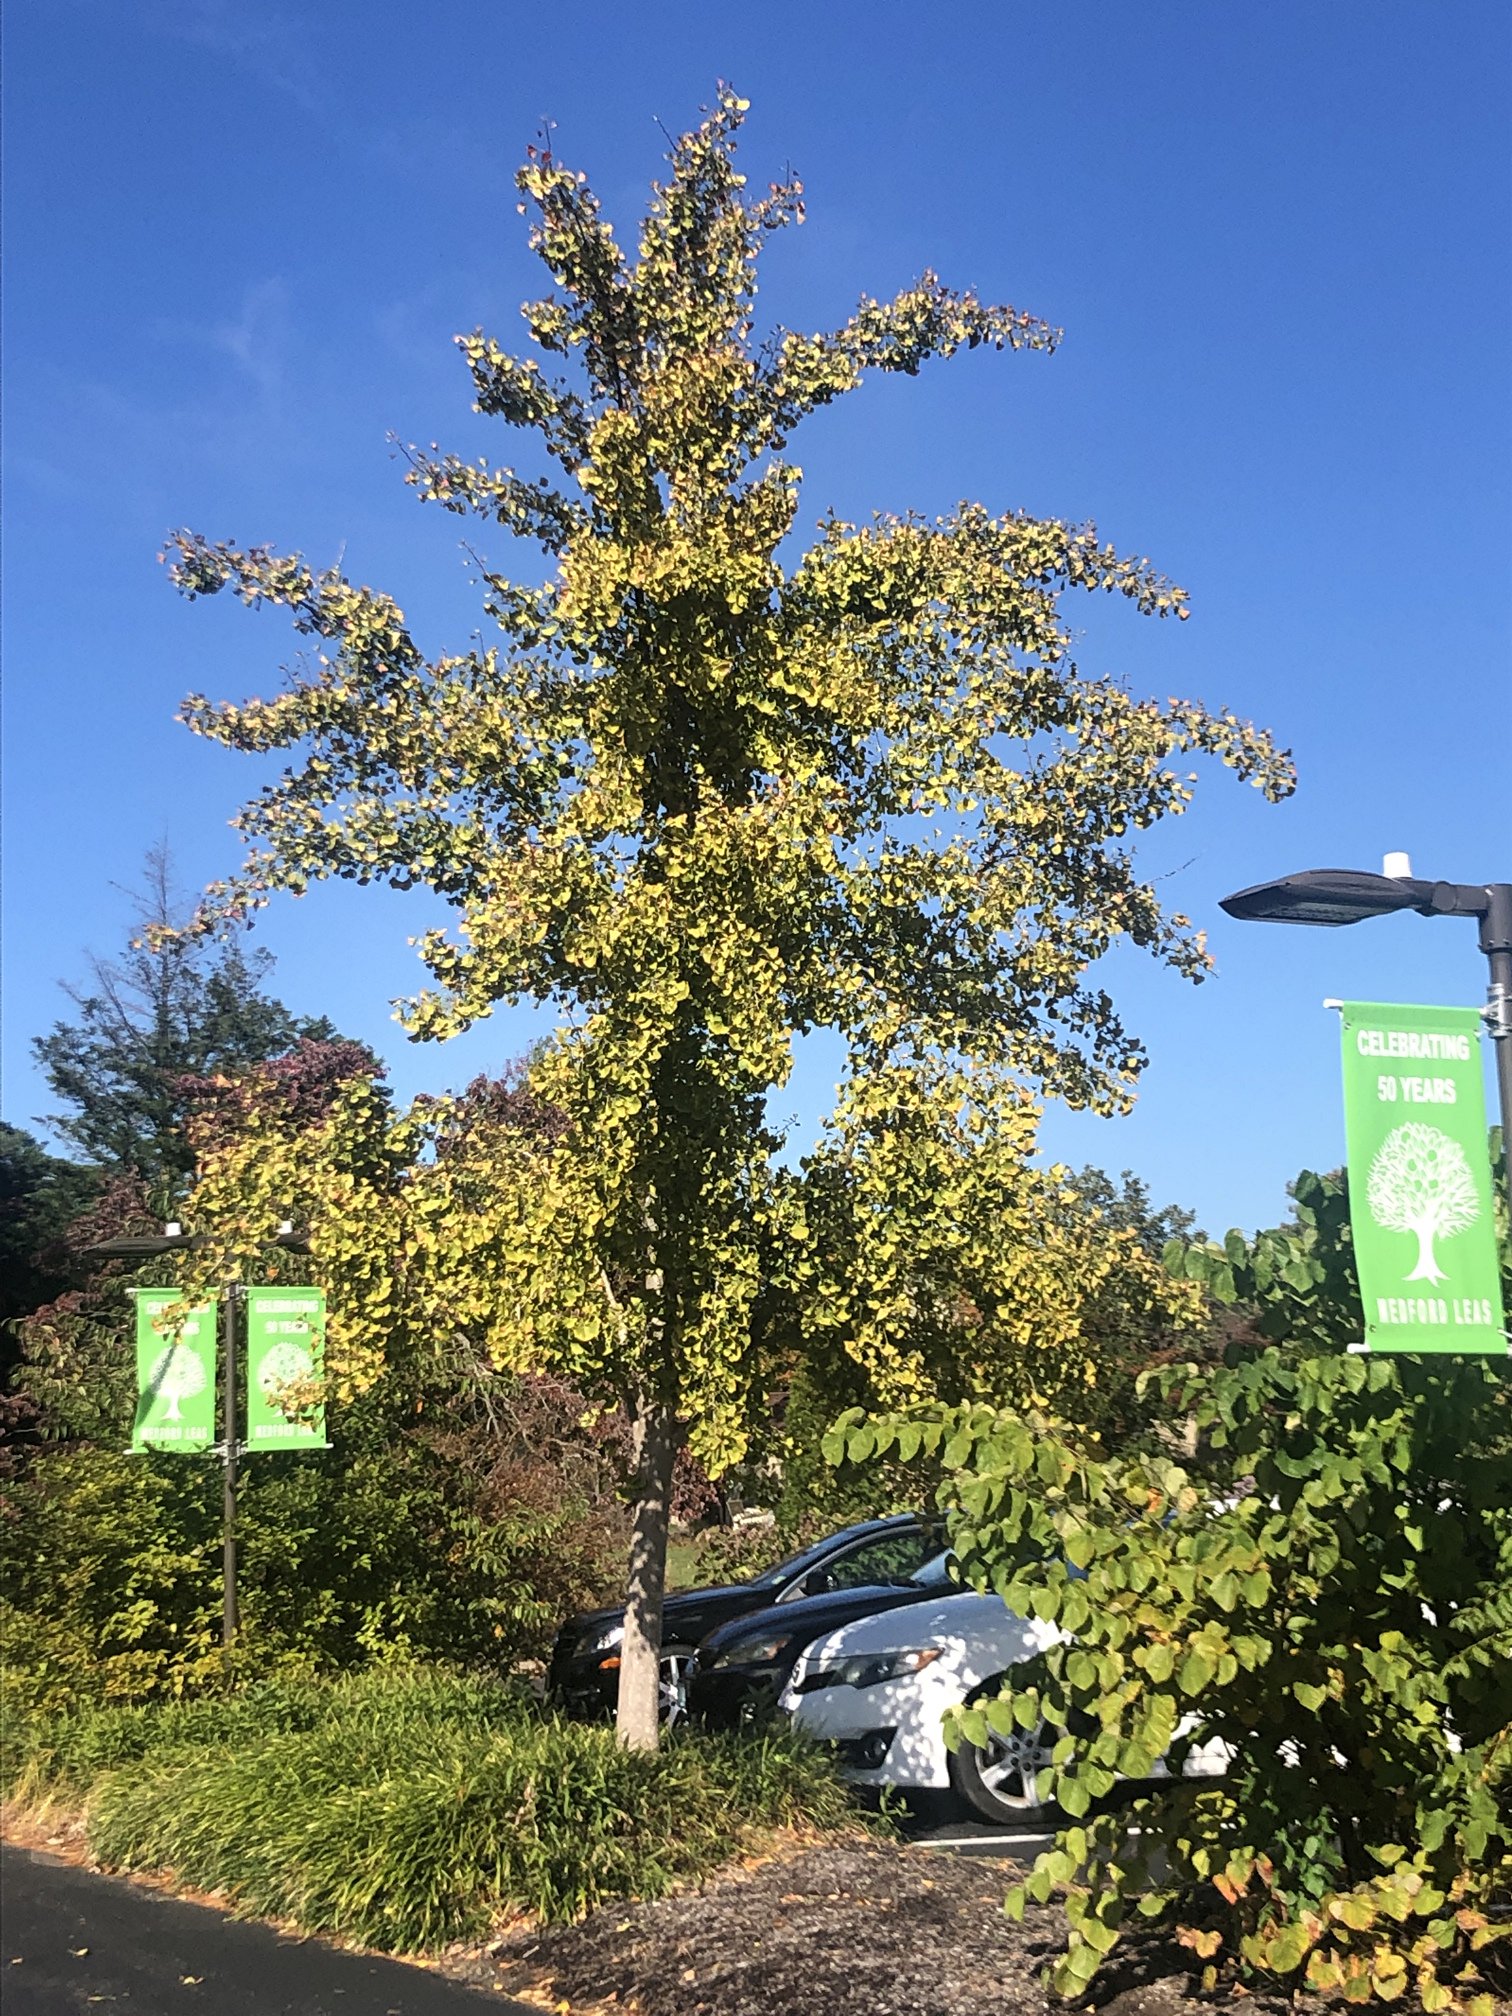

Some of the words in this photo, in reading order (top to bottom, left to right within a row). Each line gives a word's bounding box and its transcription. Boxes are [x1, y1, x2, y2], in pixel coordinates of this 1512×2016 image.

[1357, 1030, 1470, 1061] CELEBRATING
[1377, 1076, 1397, 1101] 50
[1399, 1077, 1457, 1104] YEARS
[1453, 1299, 1492, 1325] LEAS
